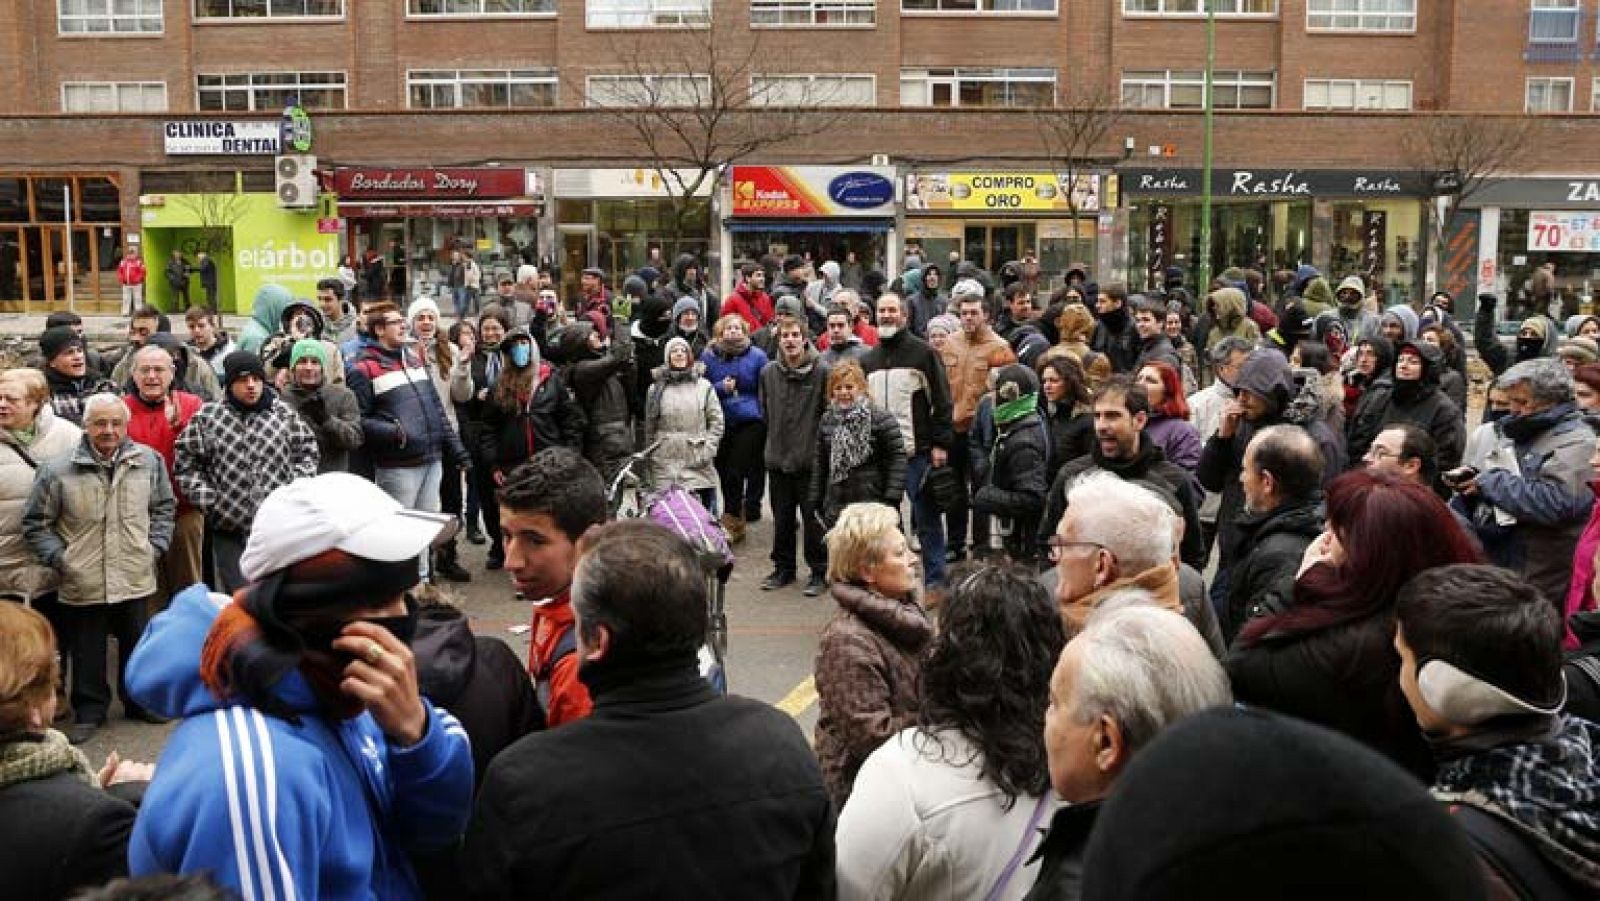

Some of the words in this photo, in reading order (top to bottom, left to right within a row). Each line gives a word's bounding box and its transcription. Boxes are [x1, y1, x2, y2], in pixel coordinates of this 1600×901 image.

[166, 122, 235, 138] CLINICA
[222, 138, 278, 151] DENTAL
[351, 173, 425, 189] Bordados
[433, 173, 478, 194] Dory
[972, 176, 1034, 188] COMPRO
[1140, 174, 1189, 189] Rasha
[1231, 170, 1311, 194] Rasha
[1354, 176, 1401, 192] Rasha
[985, 194, 1016, 207] ORO
